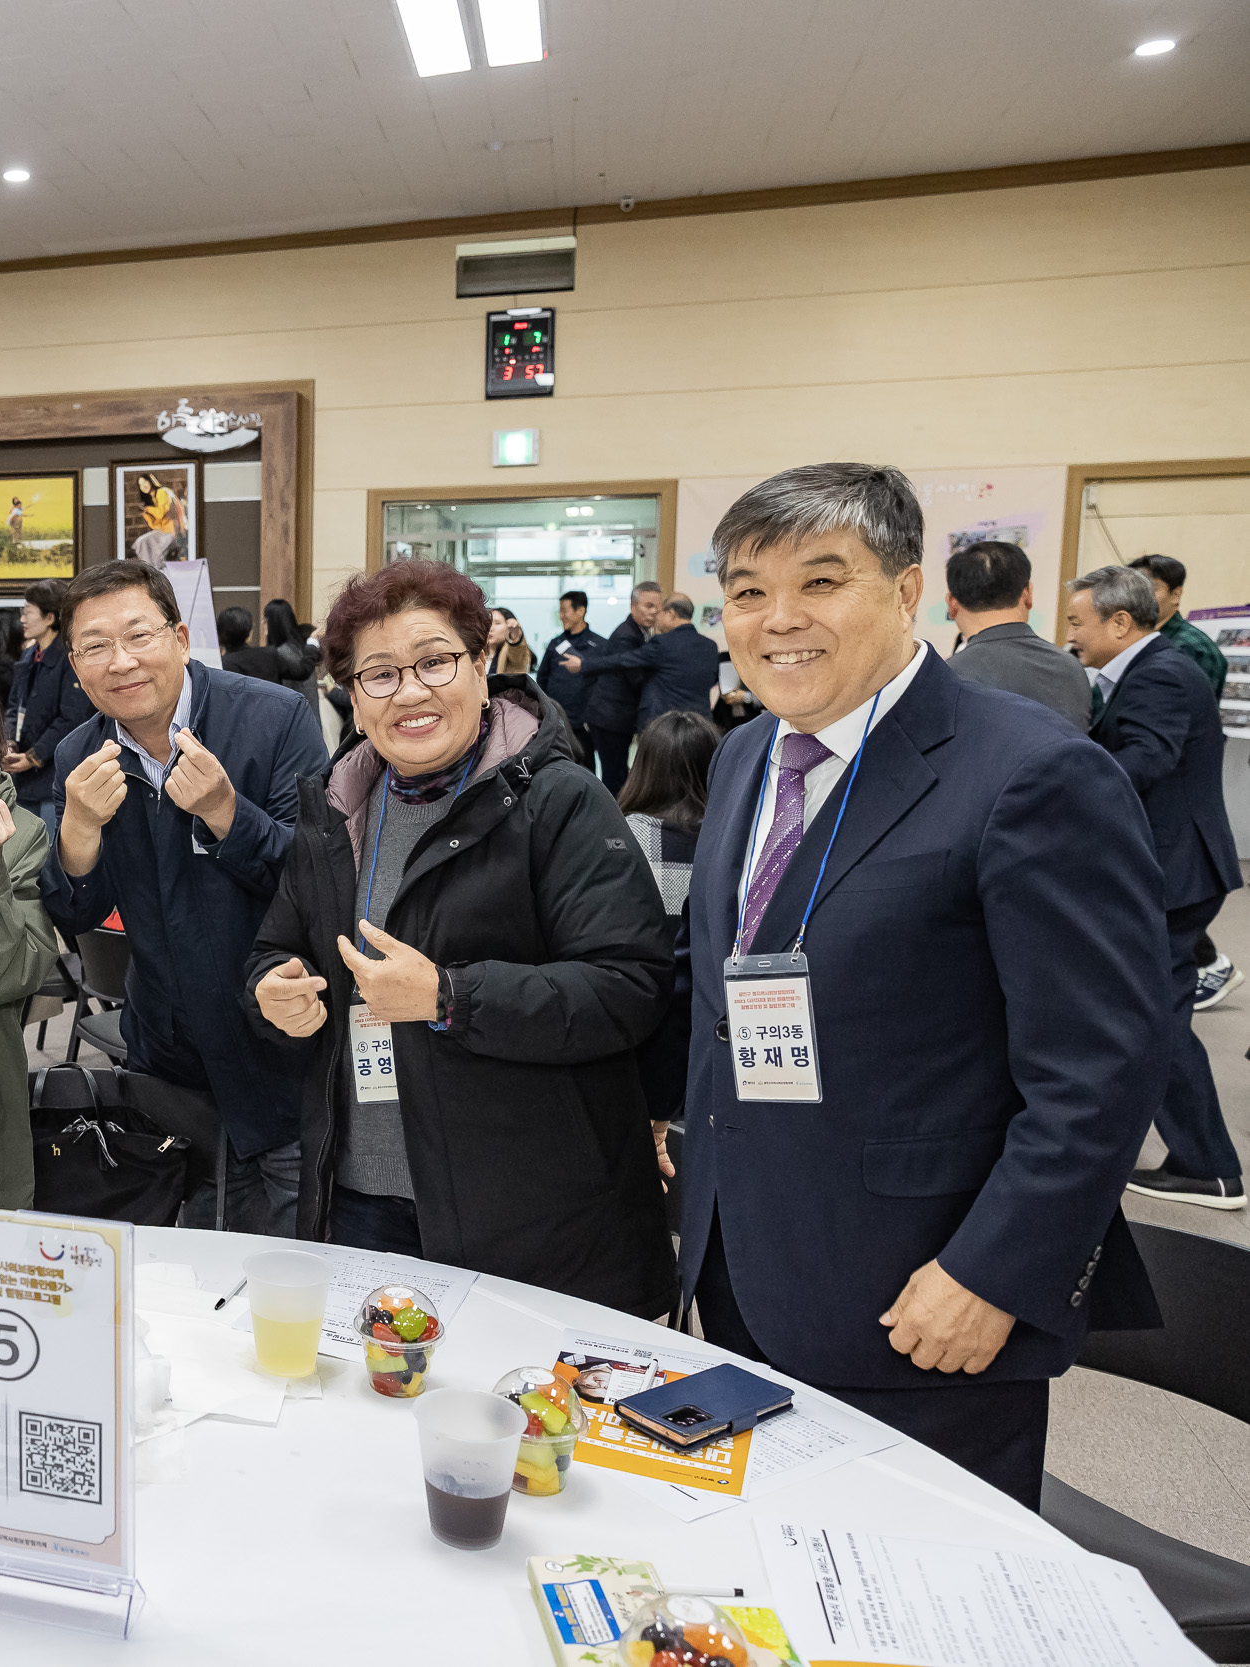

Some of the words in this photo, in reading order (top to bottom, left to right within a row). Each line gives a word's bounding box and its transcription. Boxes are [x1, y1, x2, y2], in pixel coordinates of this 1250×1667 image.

[755, 1025, 804, 1040] 구의3동
[809, 1536, 825, 1553] 신청서
[822, 1576, 838, 1601] 문자발송
